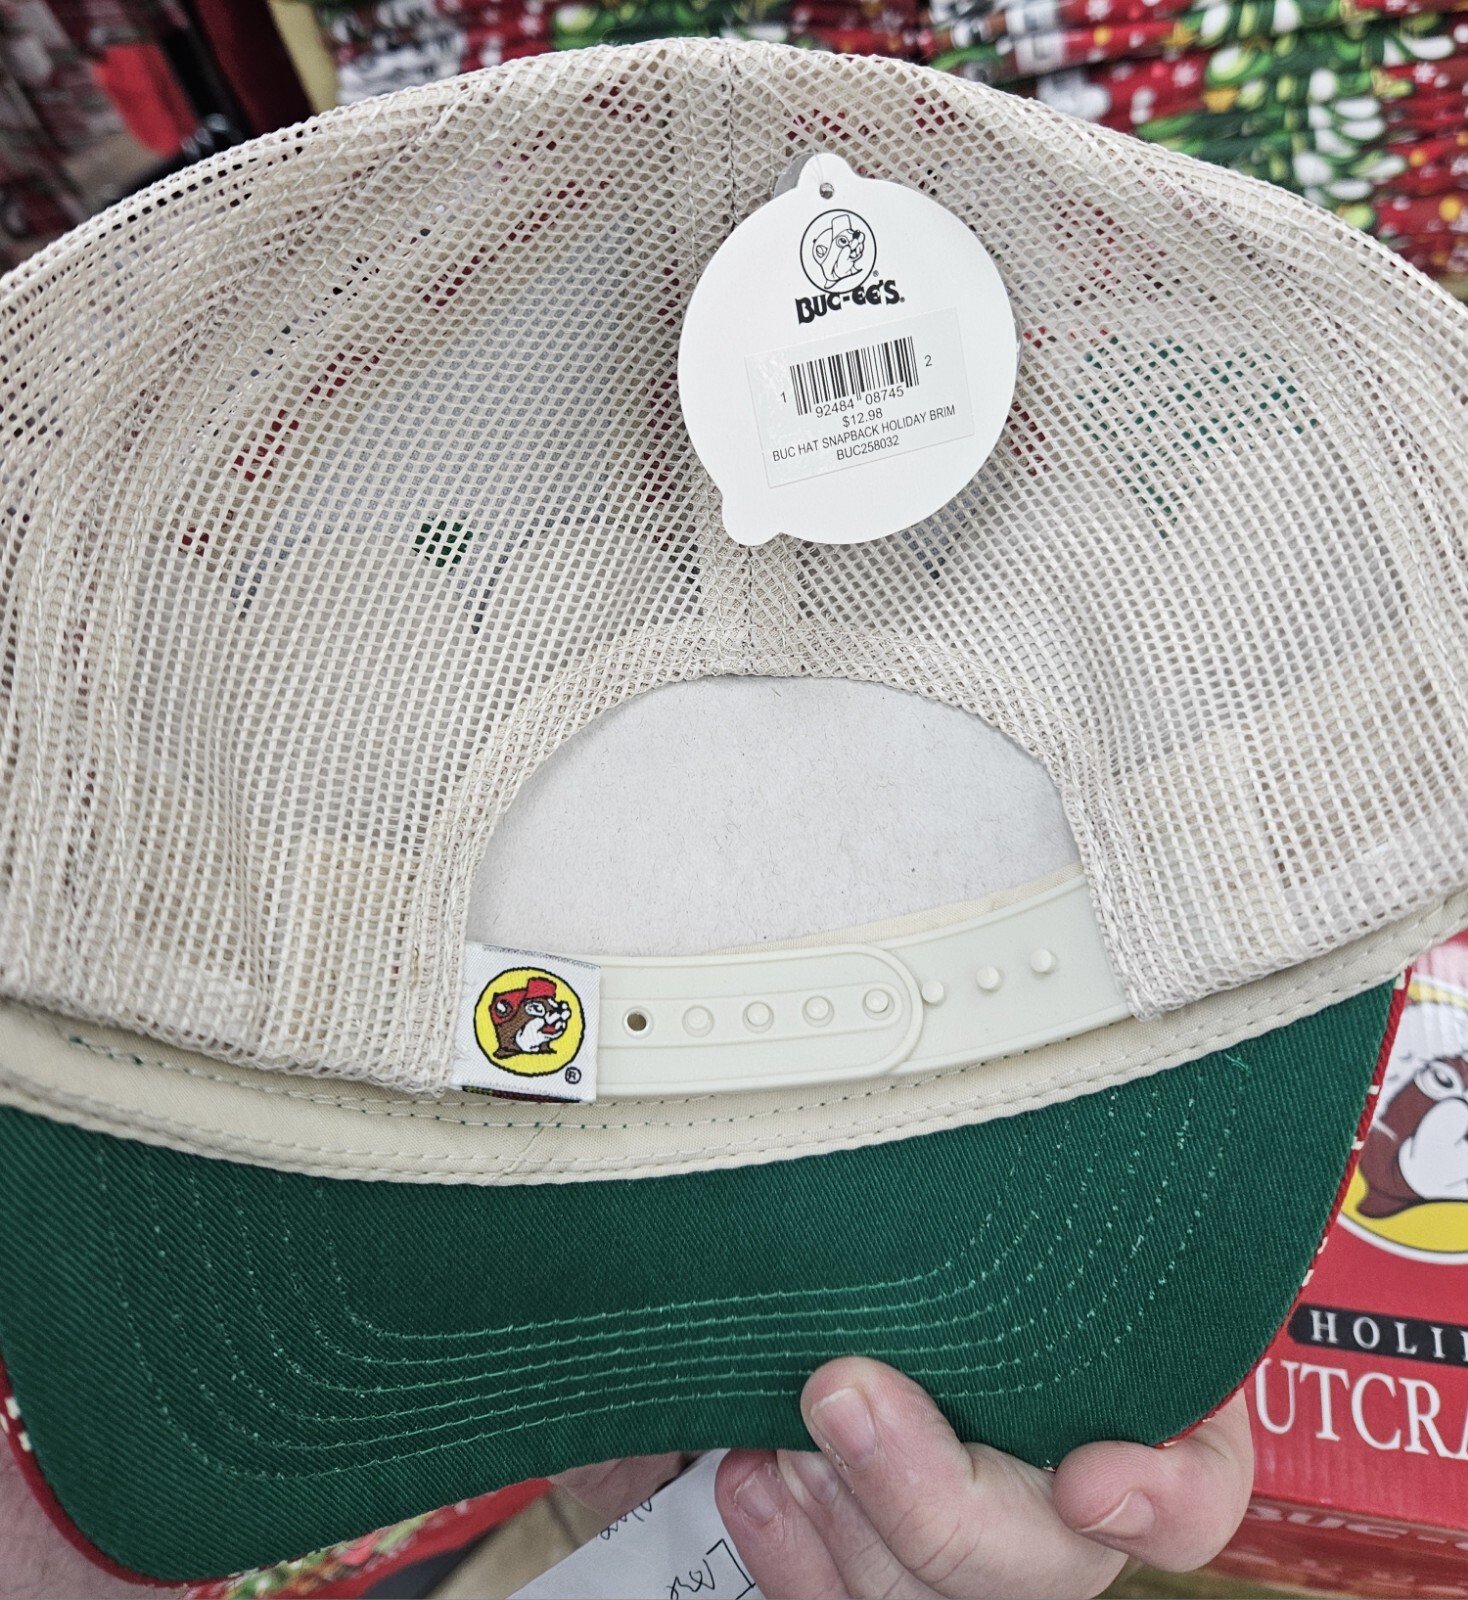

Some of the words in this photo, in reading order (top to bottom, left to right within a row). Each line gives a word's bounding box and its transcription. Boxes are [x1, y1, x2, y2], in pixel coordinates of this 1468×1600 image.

[815, 399, 855, 418] 92484
[865, 385, 905, 405] 08745
[924, 354, 933, 367] 2
[772, 446, 796, 462] BUC
[797, 439, 819, 457] HAT
[822, 423, 880, 450] SNAPBACK
[881, 411, 927, 433] HOLIDAY
[929, 404, 956, 421] BRIM
[841, 407, 884, 428] $12.98
[836, 434, 900, 461] BUC258032
[1309, 1309, 1468, 1363] HOLI
[1255, 1357, 1468, 1461] UTCR
